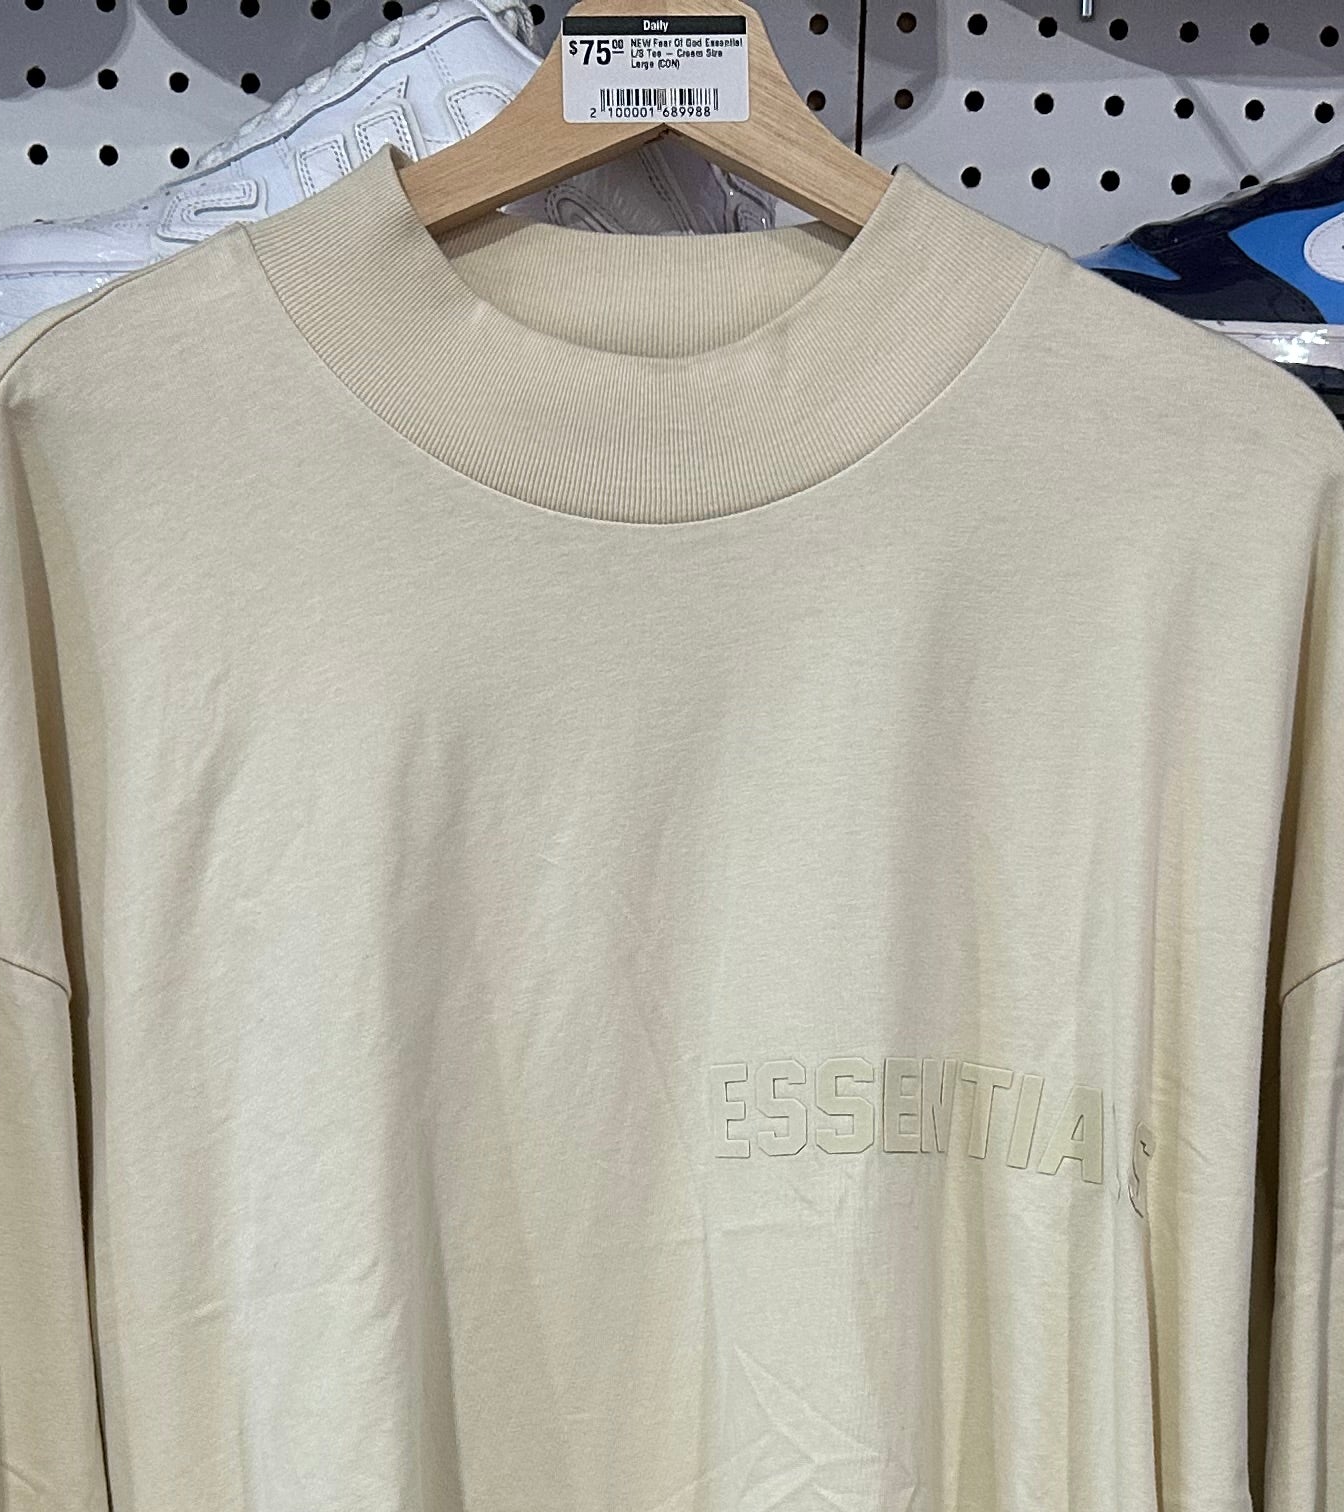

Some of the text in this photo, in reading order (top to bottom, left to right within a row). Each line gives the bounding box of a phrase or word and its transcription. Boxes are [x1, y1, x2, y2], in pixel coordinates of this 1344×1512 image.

[643, 20, 669, 32] Daily
[631, 38, 651, 47] NEW
[653, 38, 672, 47] Fear
[685, 38, 702, 47] God
[647, 49, 662, 58] Tee
[676, 49, 703, 58] Cream
[631, 59, 680, 70] Large (CON)
[590, 106, 711, 118] 2 100001 689988
[710, 1058, 1156, 1218] ESSENTIA
